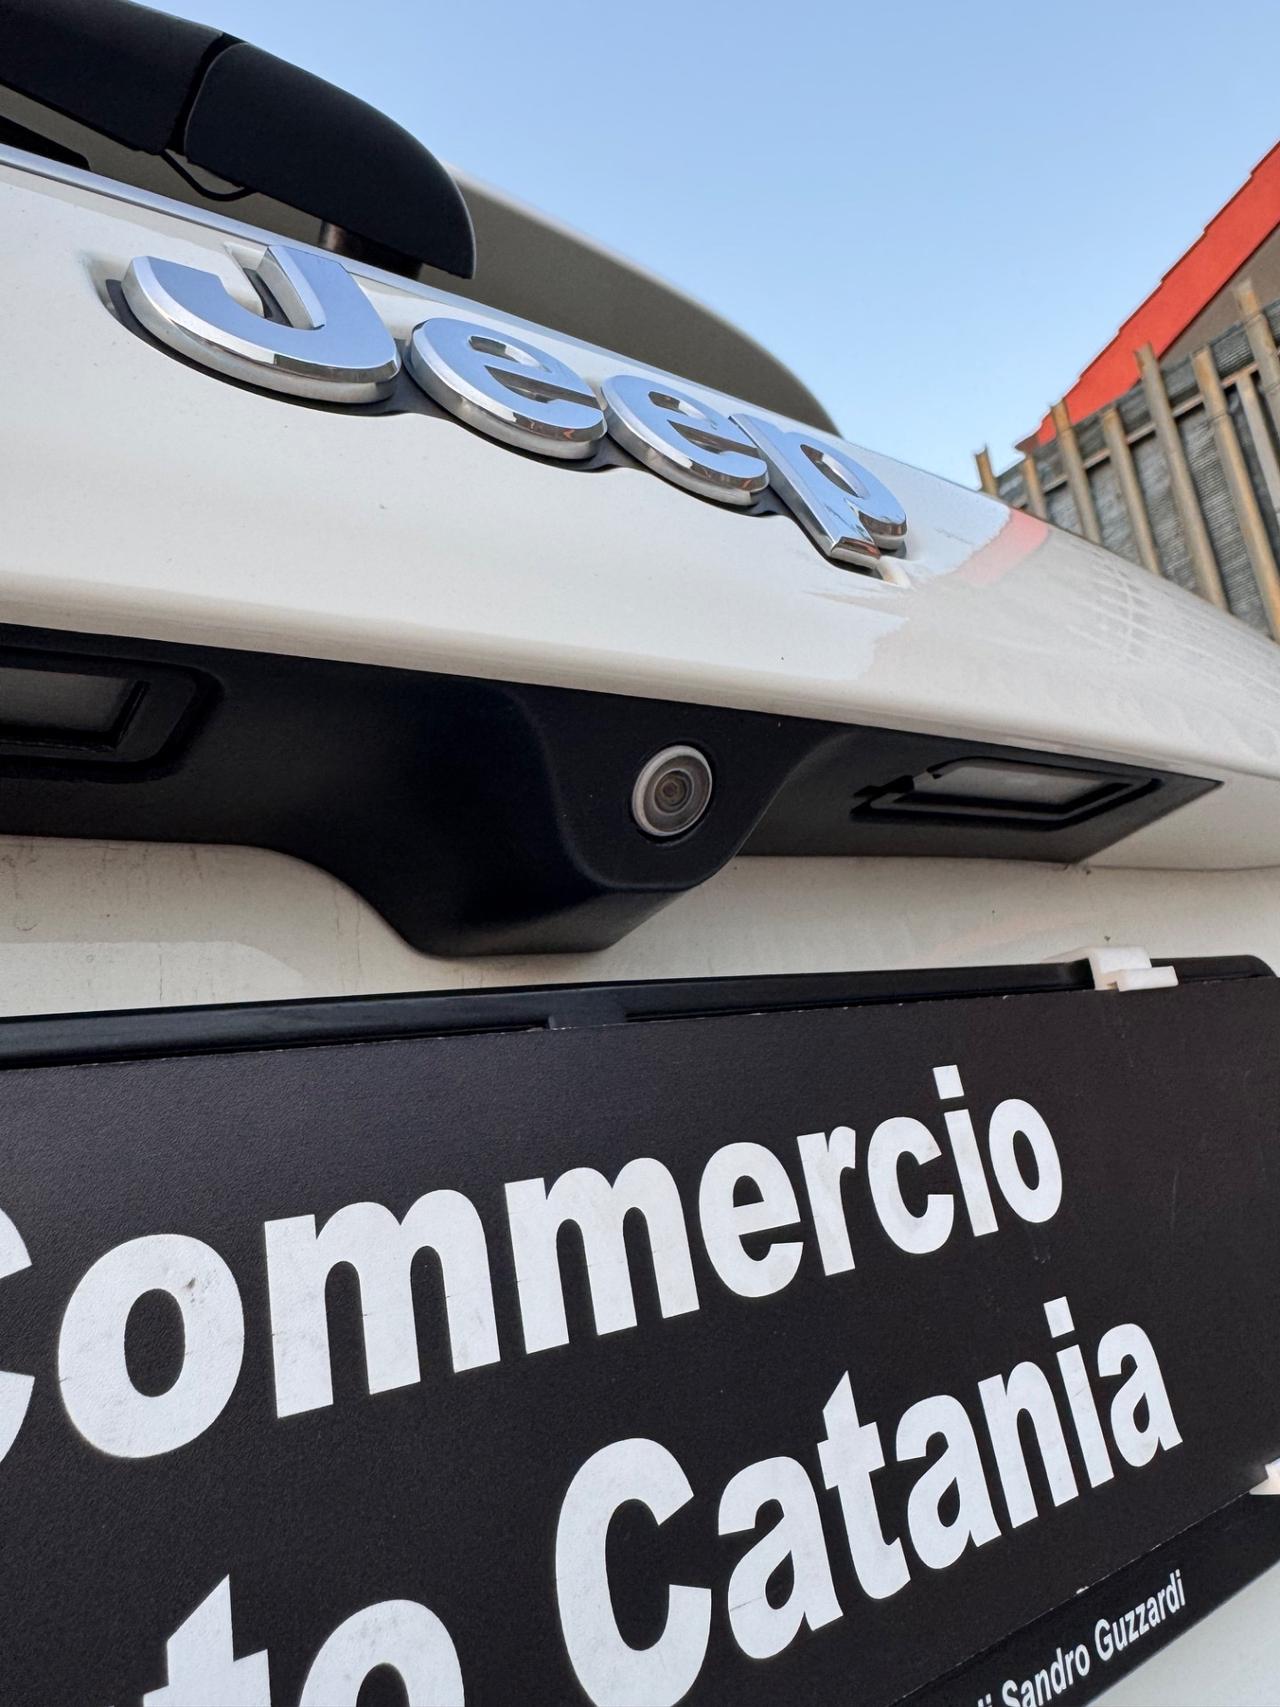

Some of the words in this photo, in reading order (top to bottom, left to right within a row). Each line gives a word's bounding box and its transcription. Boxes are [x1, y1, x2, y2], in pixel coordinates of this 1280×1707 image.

[120, 244, 908, 569] Jeep
[0, 1064, 1063, 1465] ommercio
[555, 1296, 1183, 1707] Catania
[1002, 1644, 1090, 1707] Sandro
[1094, 1569, 1186, 1661] Guzzardi
